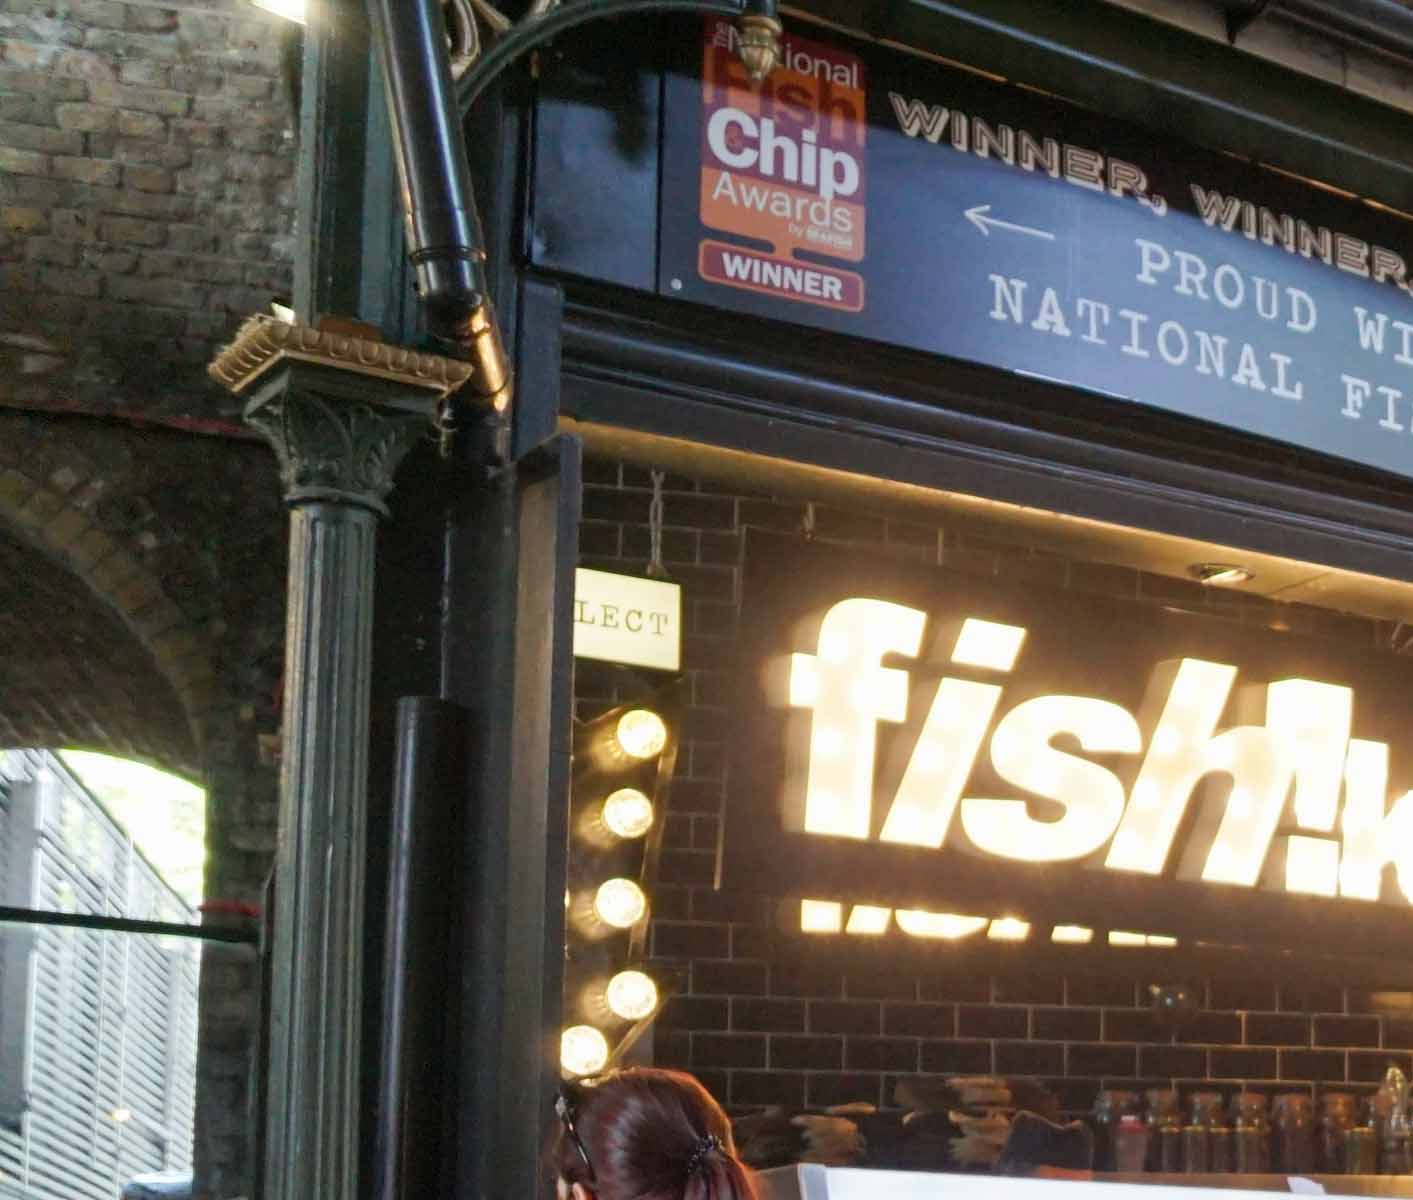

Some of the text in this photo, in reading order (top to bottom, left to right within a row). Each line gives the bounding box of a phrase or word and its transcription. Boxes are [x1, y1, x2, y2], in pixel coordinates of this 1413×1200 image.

[707, 107, 860, 200] Chip
[889, 92, 1167, 216] WINNER,
[712, 171, 853, 232] Awards
[721, 252, 843, 301] WINNER
[1136, 238, 1317, 333] PROUD
[988, 274, 1303, 401] NATIONAL
